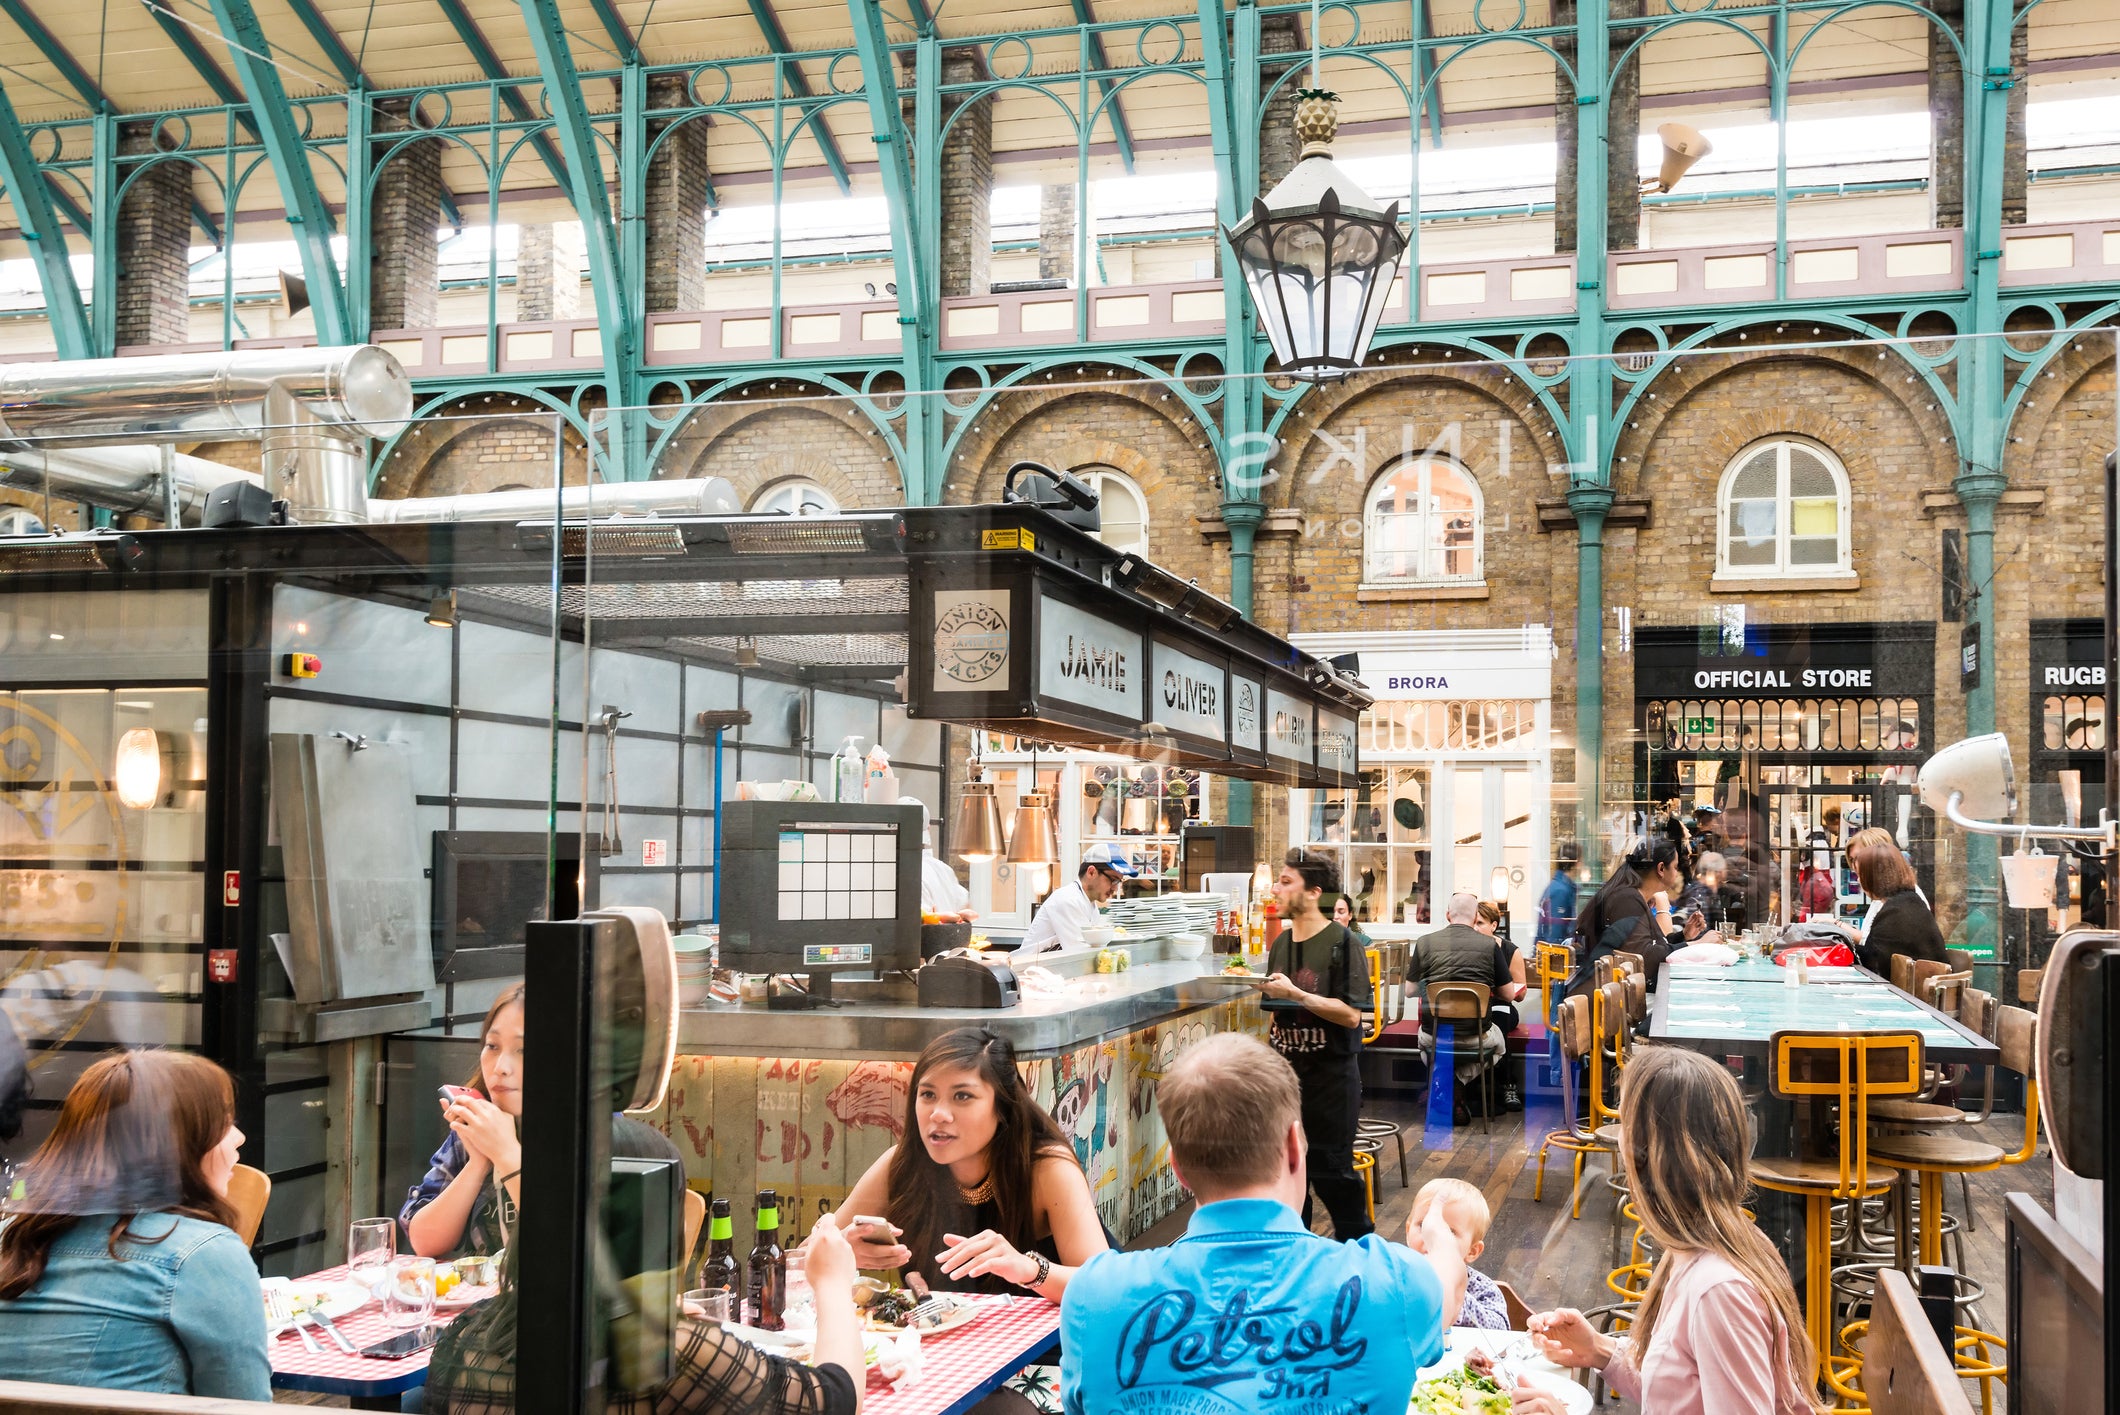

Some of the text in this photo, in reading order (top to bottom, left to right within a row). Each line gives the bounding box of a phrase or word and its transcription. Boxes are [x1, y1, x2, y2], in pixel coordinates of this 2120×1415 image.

[941, 607, 1001, 633] UNION
[1060, 635, 1126, 693] JAMIE
[1164, 669, 1216, 719] OLIVER
[1388, 676, 1449, 689] BRORA
[1694, 669, 1872, 689] OFFICIAL STORE
[2044, 666, 2107, 685] RUGB
[1275, 710, 1305, 748] CHRIS
[1115, 1274, 1369, 1389] Petrol
[1120, 1390, 1156, 1412] UNION
[1160, 1389, 1194, 1409] MADE
